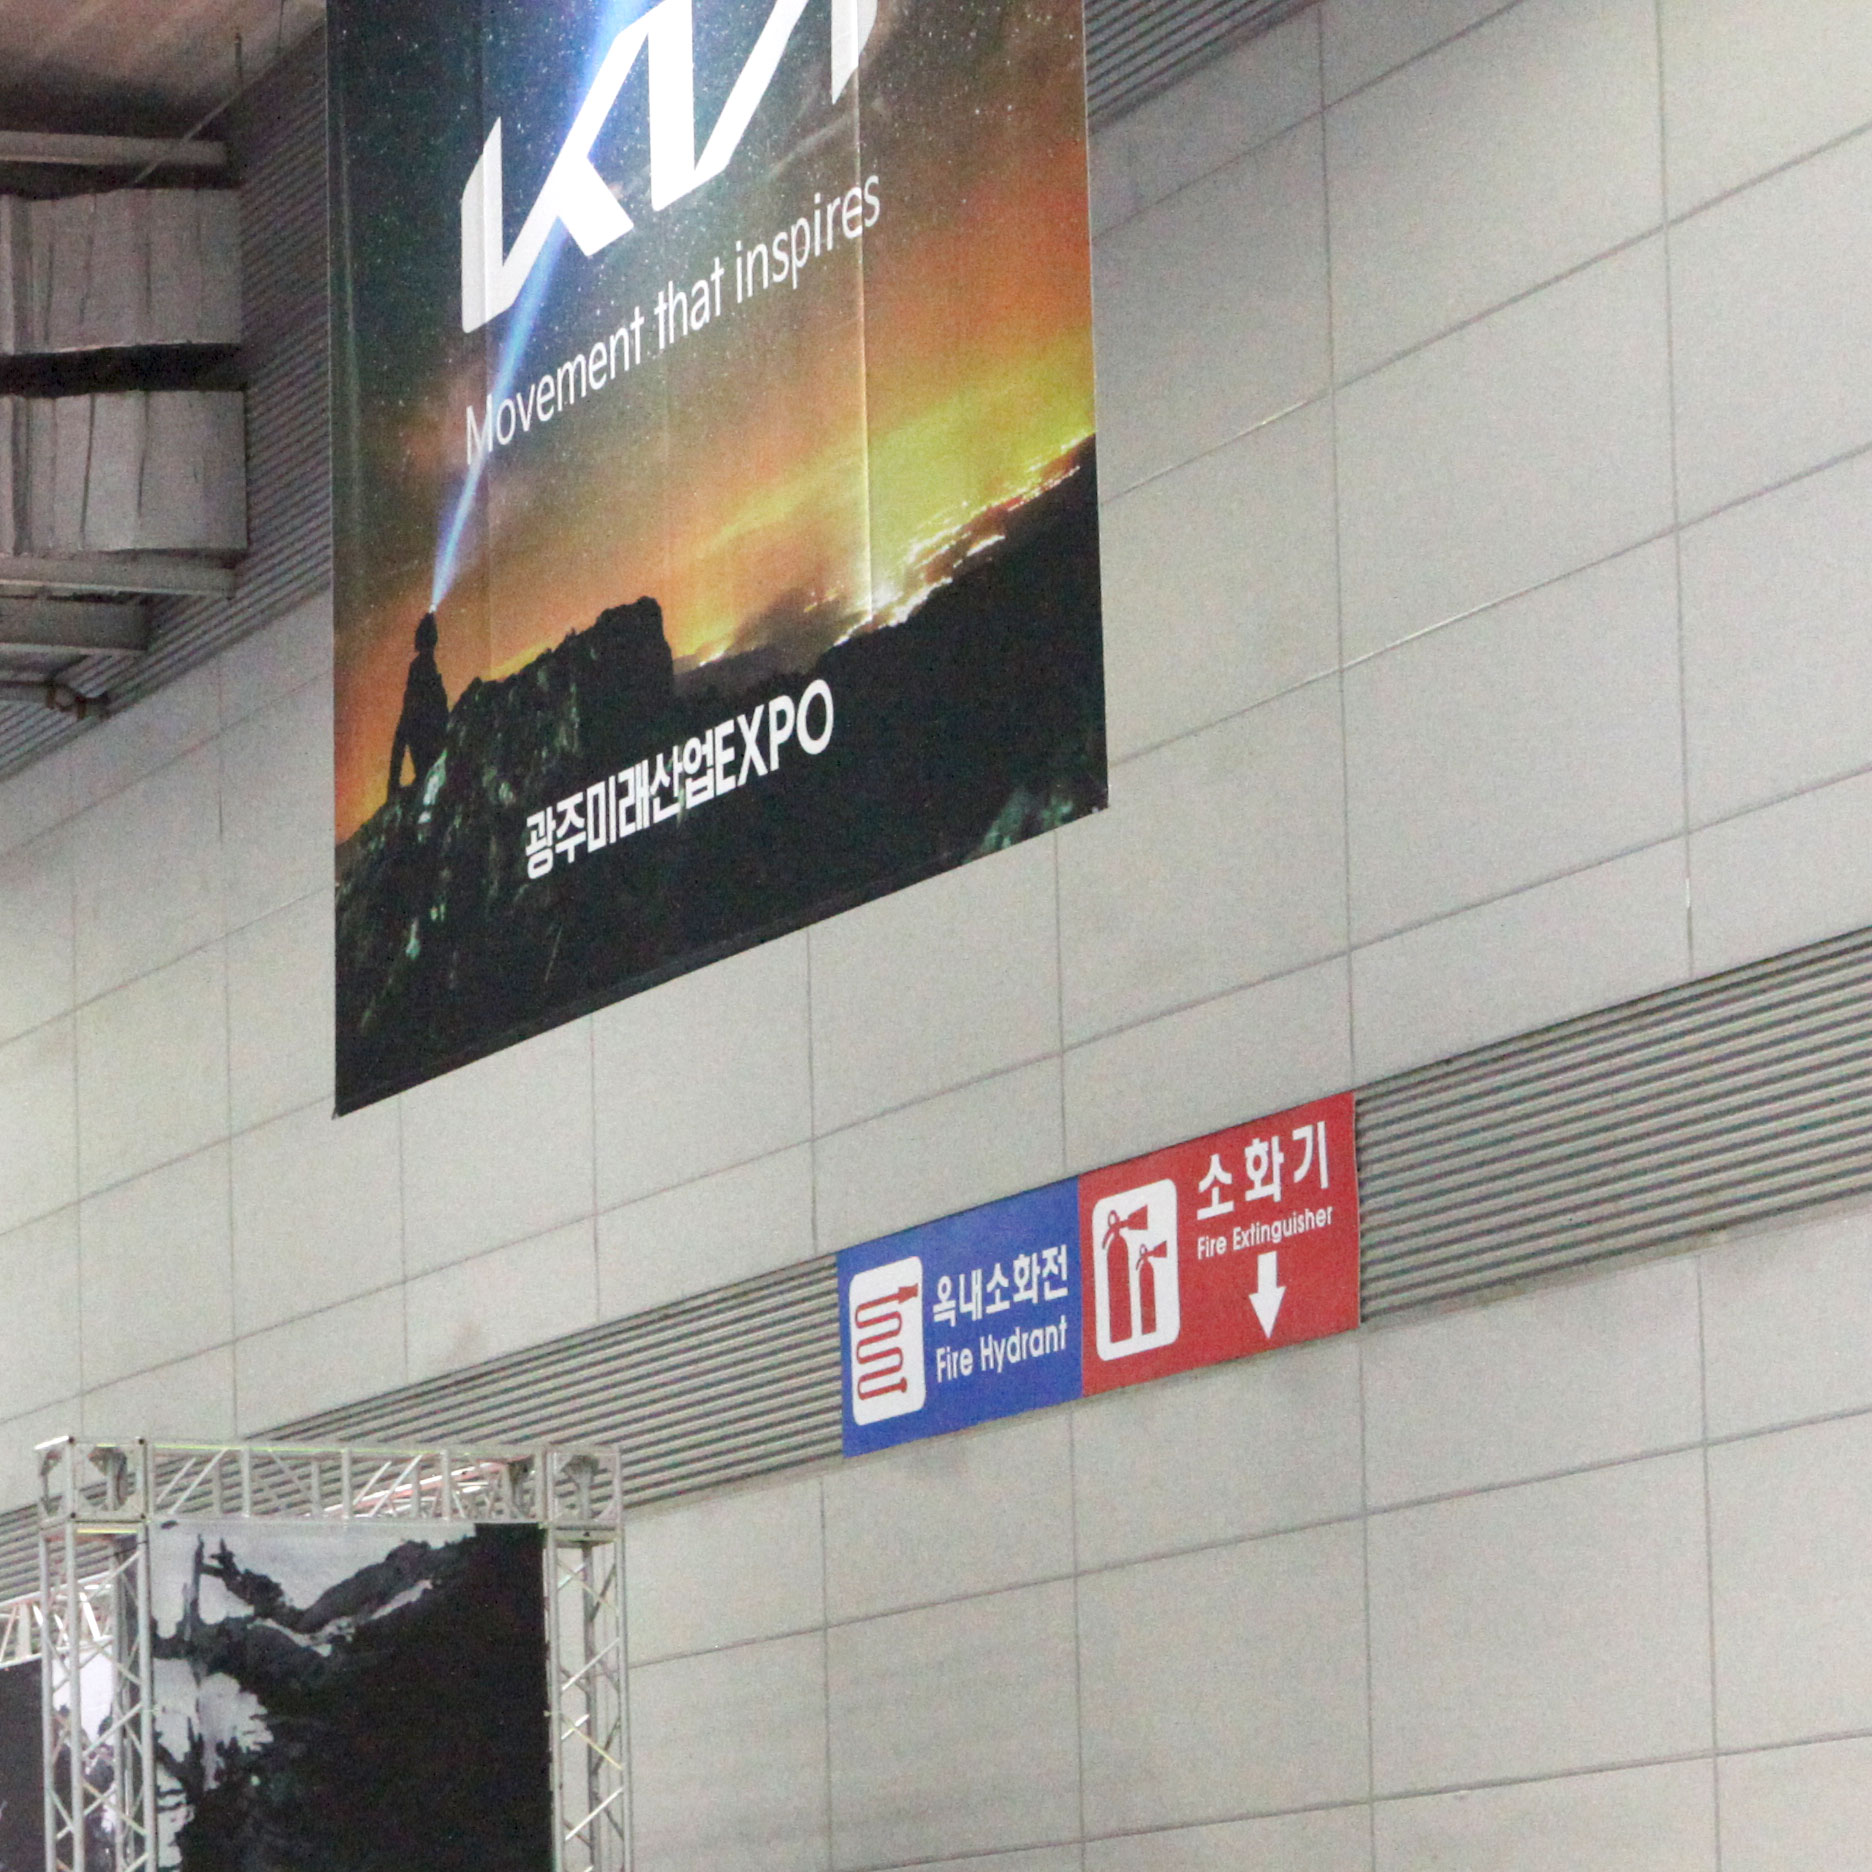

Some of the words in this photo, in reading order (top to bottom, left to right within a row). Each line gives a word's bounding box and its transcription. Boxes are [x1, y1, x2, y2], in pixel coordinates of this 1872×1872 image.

[465, 304, 643, 465] Movement
[654, 265, 725, 352] that
[735, 171, 880, 306] inspires
[525, 678, 834, 880] 광주미래산업EXPO
[1196, 1120, 1329, 1221] 소화기
[1197, 1236, 1227, 1260] Fire
[1232, 1206, 1334, 1251] Extinguisher
[932, 1244, 1069, 1328] 옥내소화전
[936, 1345, 973, 1383] Fire
[979, 1319, 1067, 1374] Hydrant
